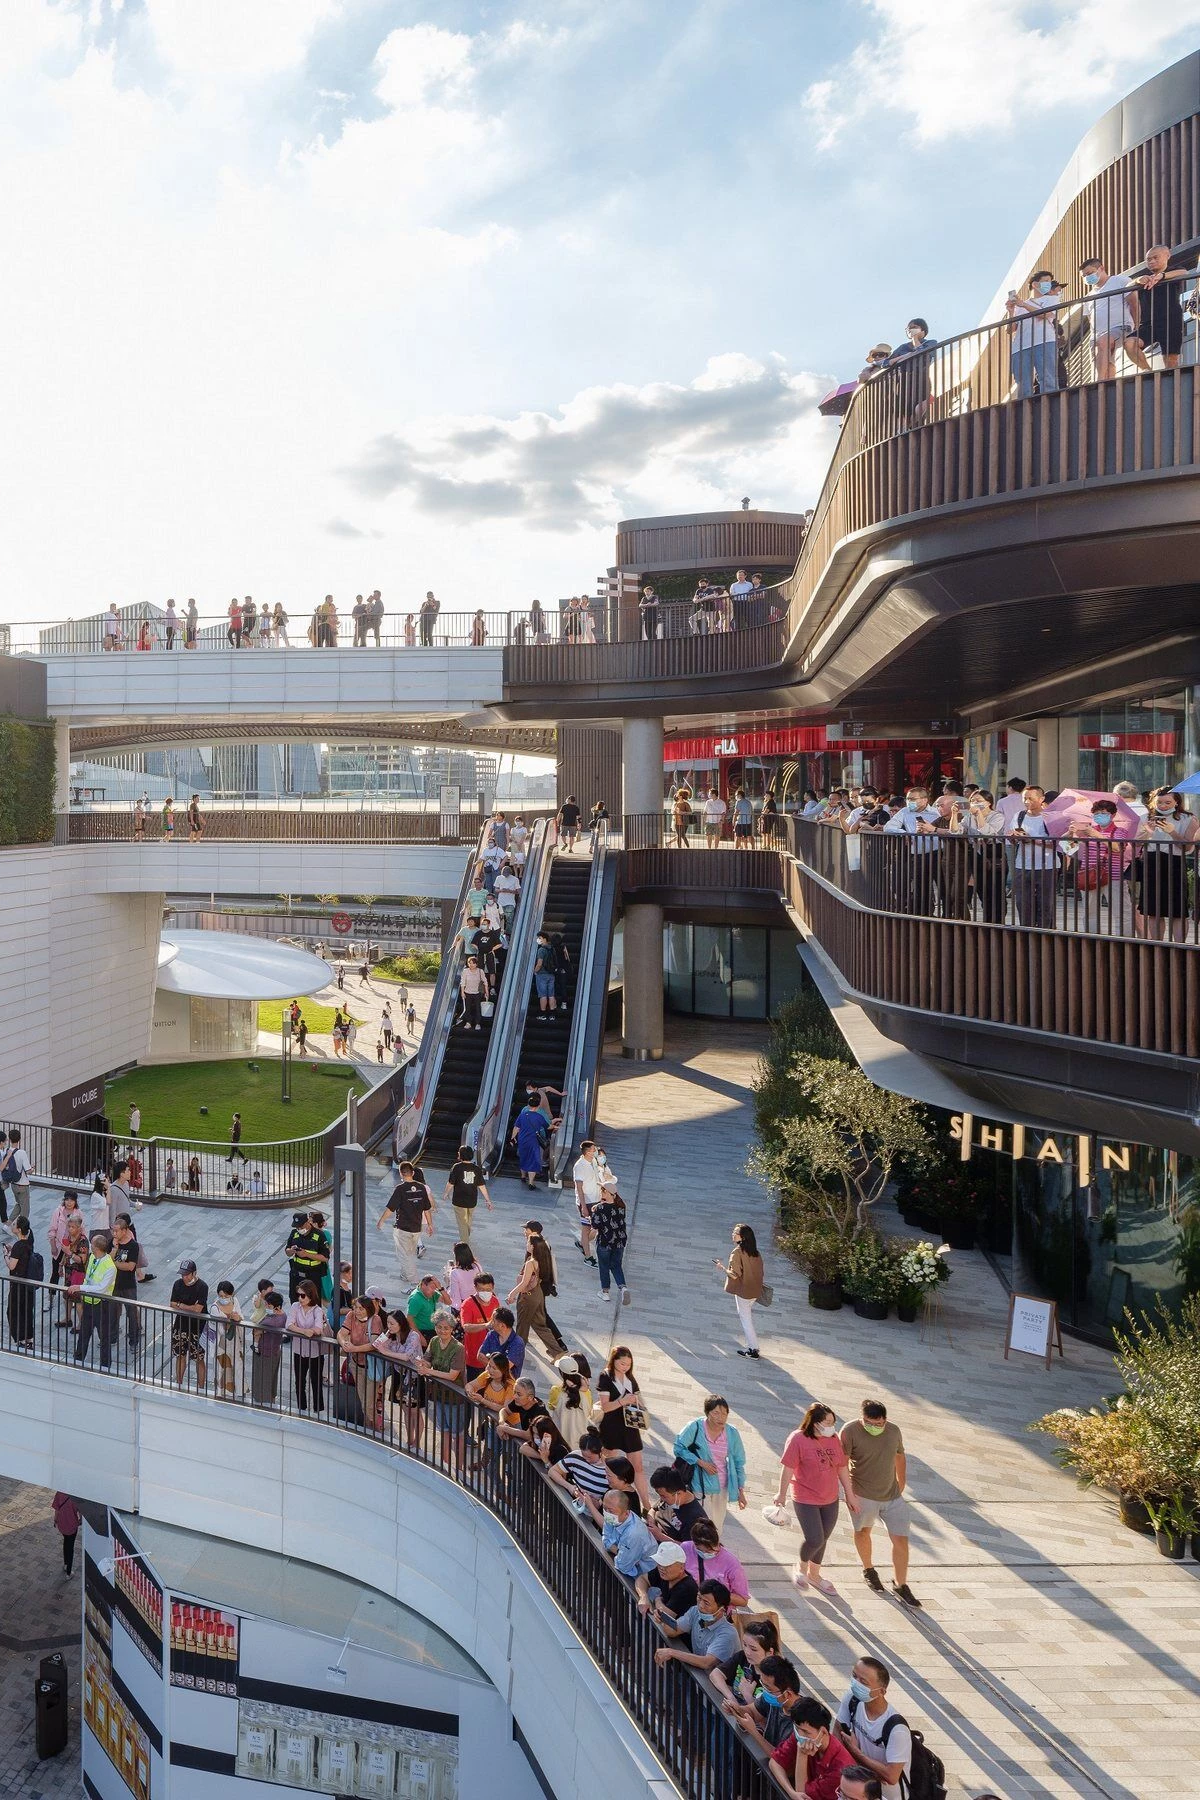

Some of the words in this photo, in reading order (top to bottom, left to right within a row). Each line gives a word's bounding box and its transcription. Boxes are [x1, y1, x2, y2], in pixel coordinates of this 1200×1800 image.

[714, 738, 739, 755] FILA
[353, 928, 380, 936] ORIENTAL
[1020, 1310, 1047, 1321] PRIVATE
[1022, 1316, 1043, 1324] PARTY
